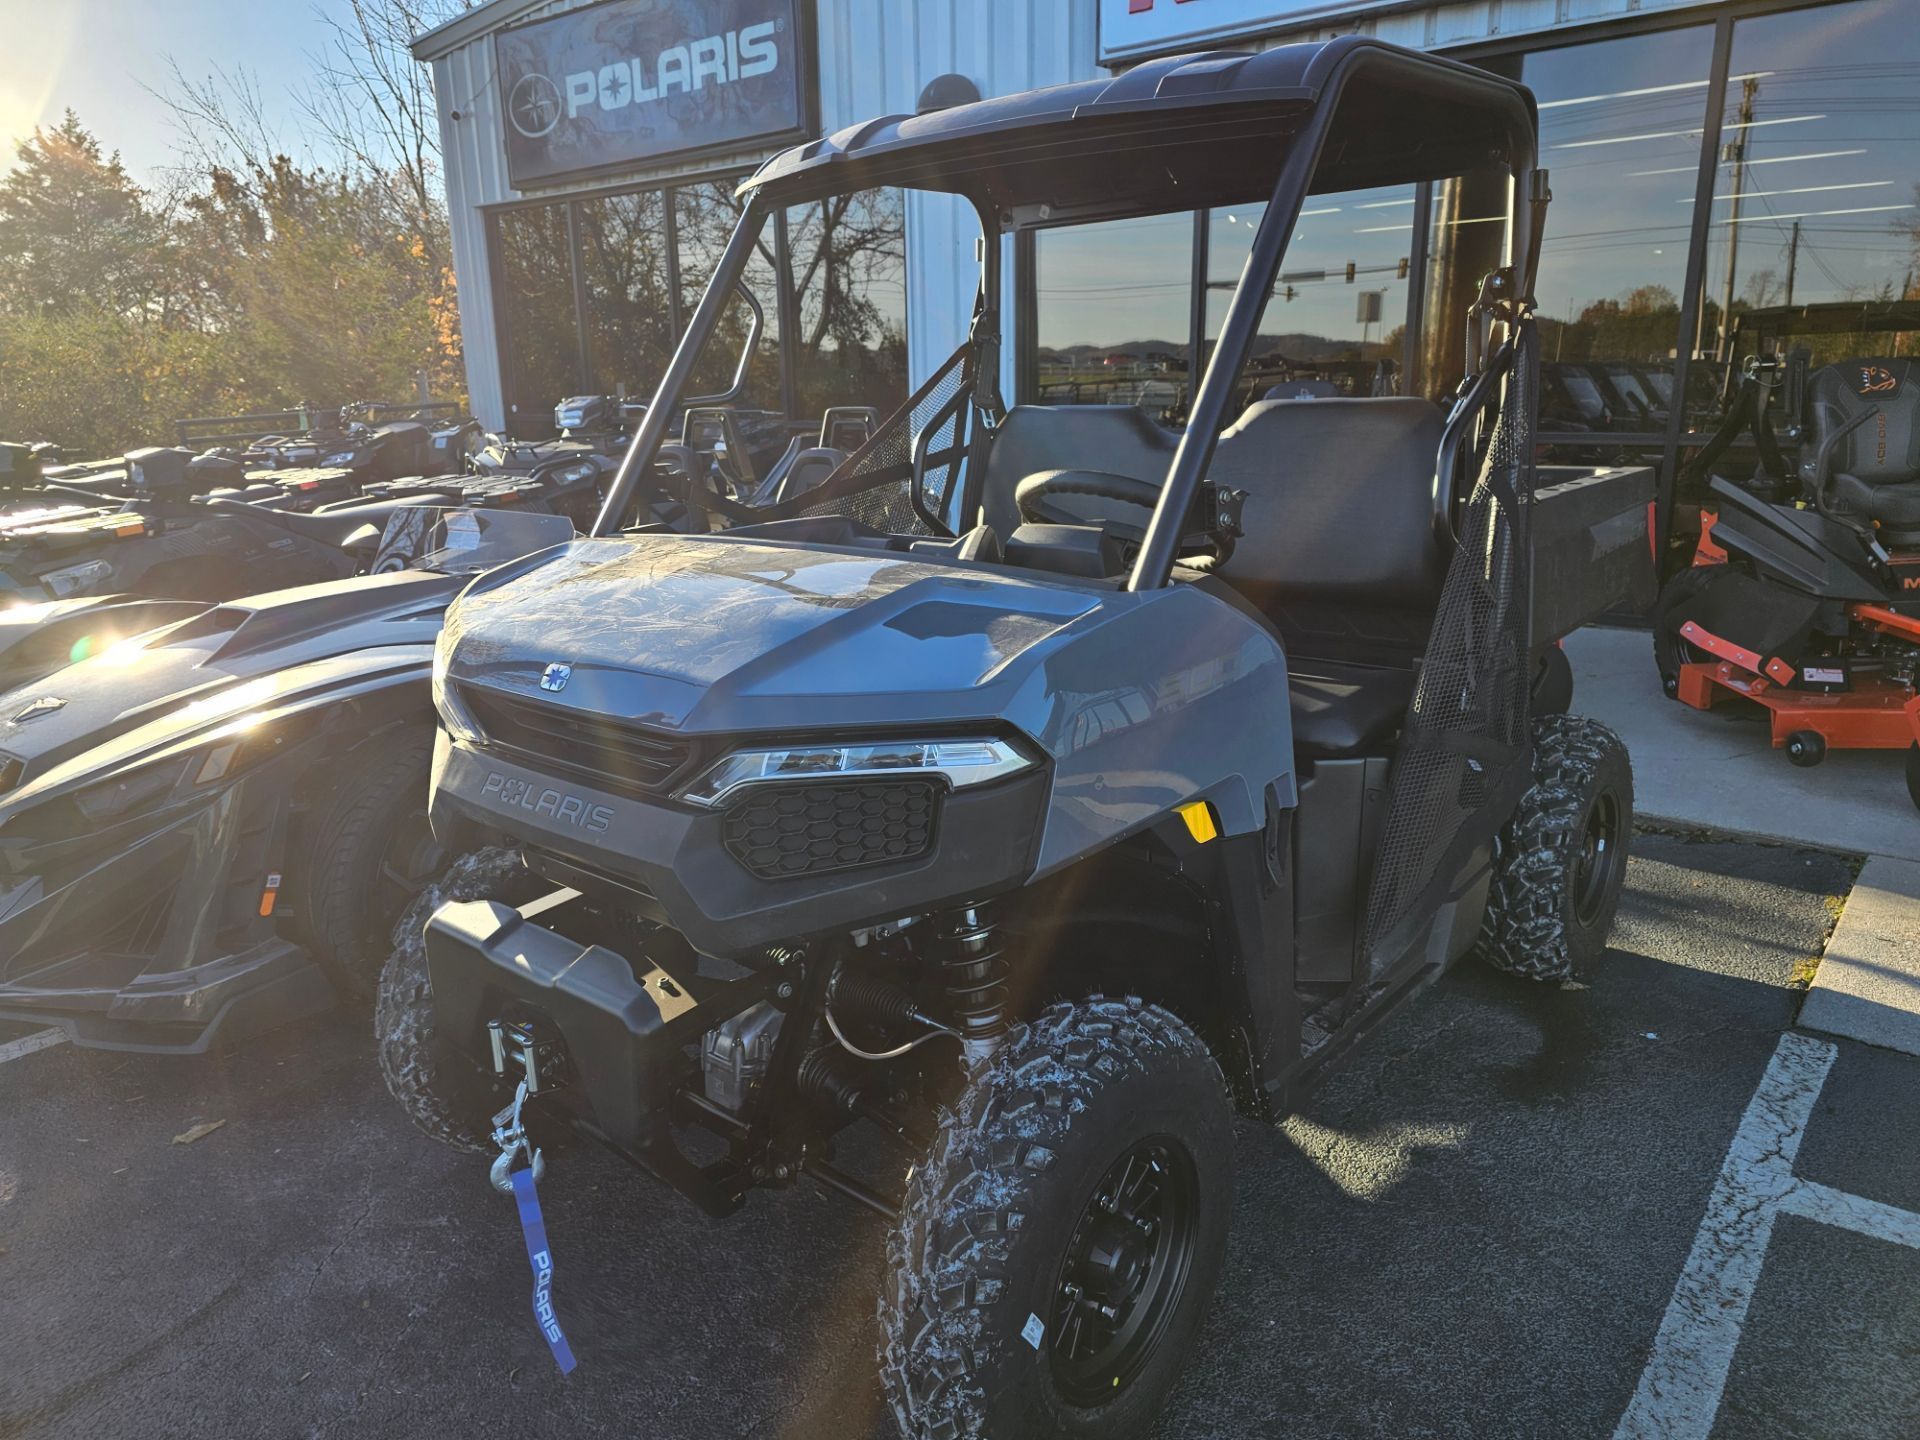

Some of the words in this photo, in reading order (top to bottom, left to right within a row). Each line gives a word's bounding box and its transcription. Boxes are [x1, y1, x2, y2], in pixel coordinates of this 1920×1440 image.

[565, 21, 778, 119] POLARIS
[480, 771, 615, 833] POLARIS
[534, 1251, 562, 1343] POLARIS
